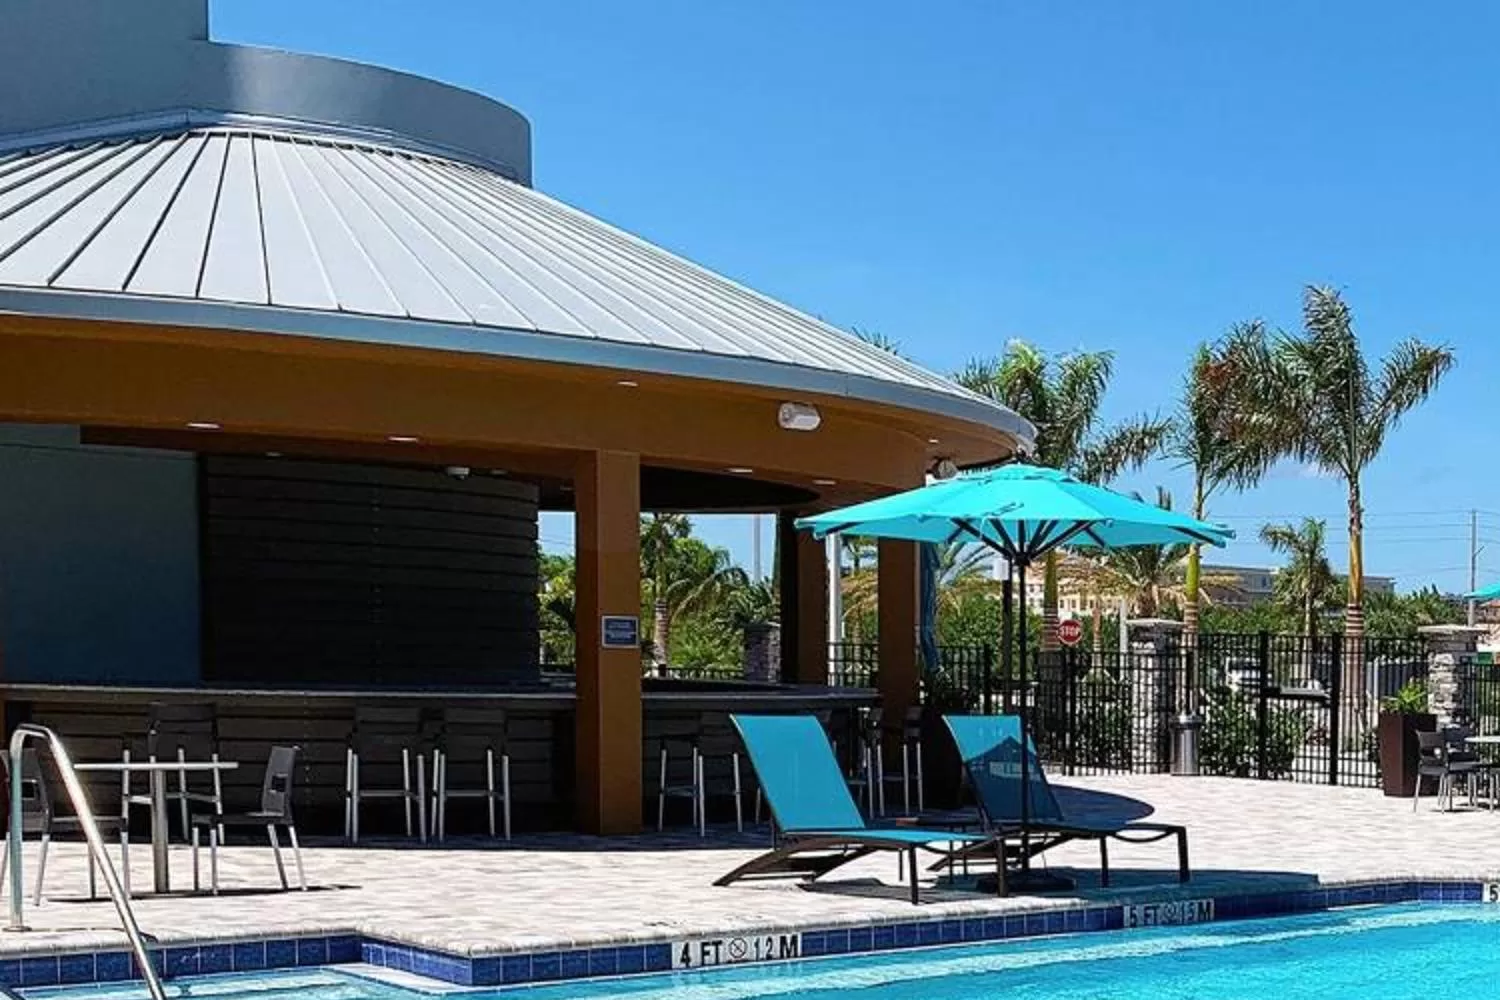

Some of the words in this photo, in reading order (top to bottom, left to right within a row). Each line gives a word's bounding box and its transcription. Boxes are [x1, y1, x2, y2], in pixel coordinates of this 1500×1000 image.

[1489, 884, 1499, 902] 5
[680, 941, 691, 968] 4
[701, 940, 723, 966] FT
